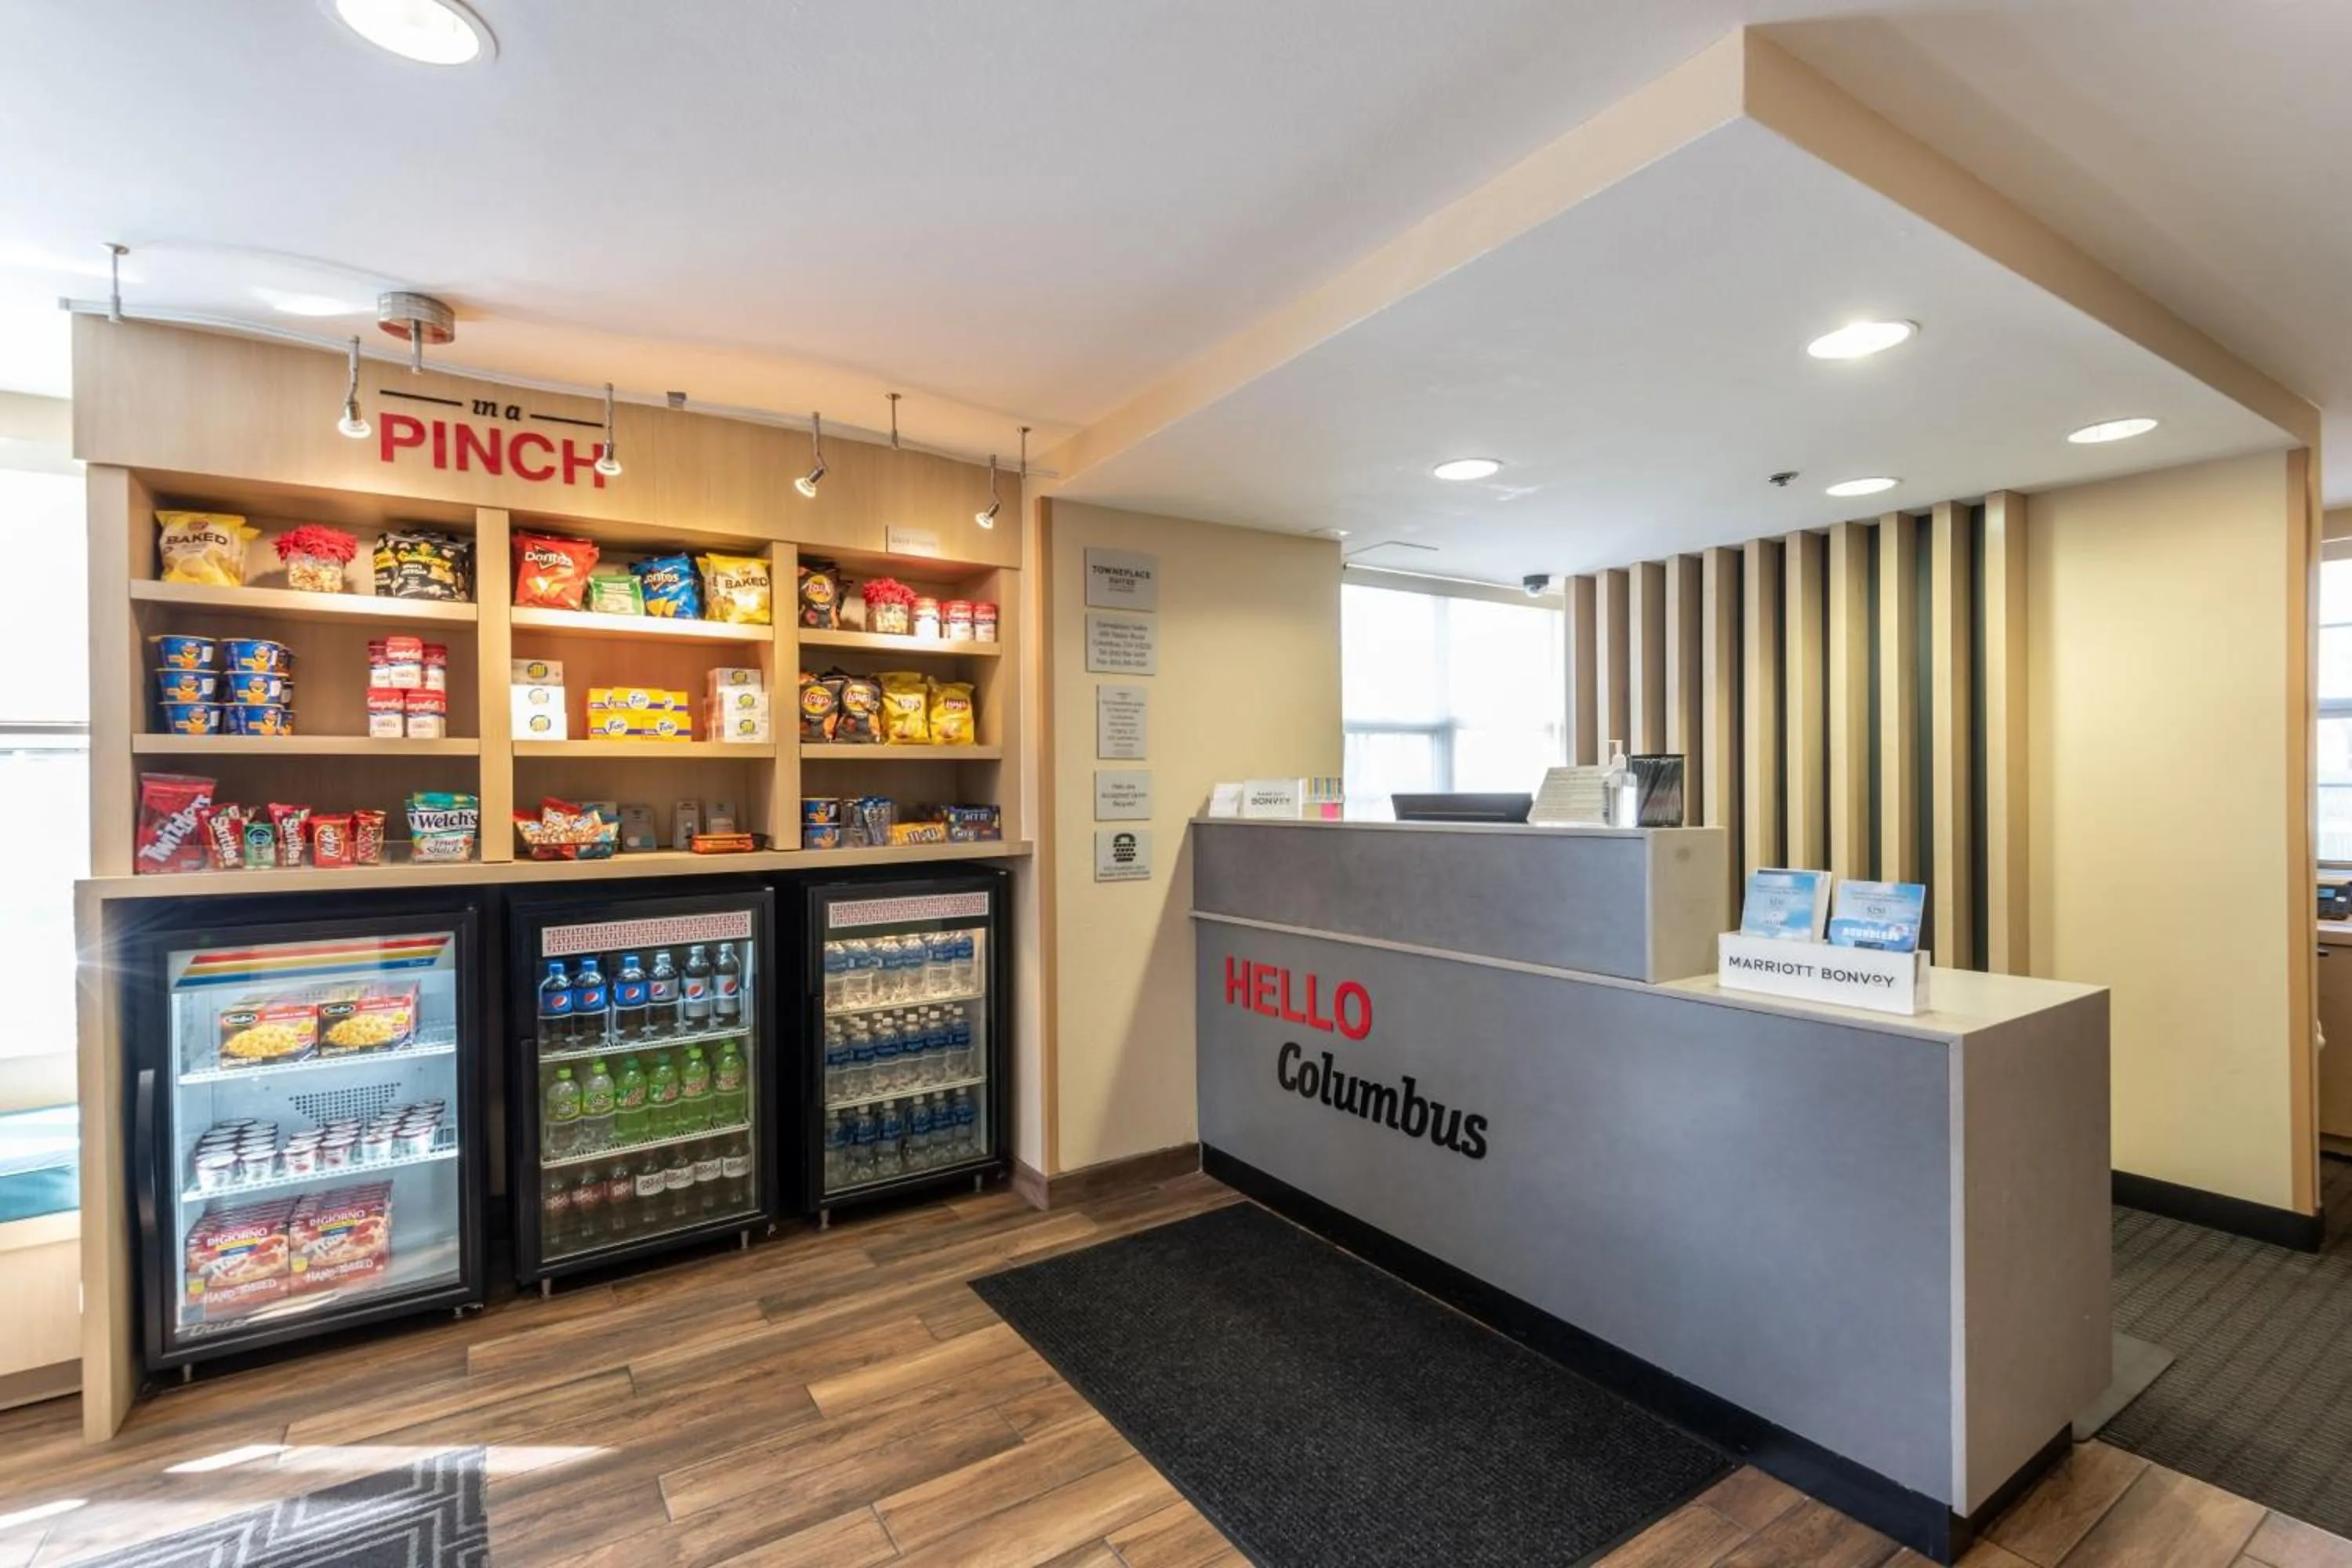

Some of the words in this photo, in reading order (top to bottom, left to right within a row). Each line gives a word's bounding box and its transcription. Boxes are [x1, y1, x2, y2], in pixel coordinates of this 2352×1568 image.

[472, 399, 498, 417] in
[505, 405, 521, 421] a
[379, 412, 605, 488] PINCH
[165, 532, 228, 545] BAKED
[725, 576, 768, 589] BAKED
[418, 811, 478, 829] Welch's
[1728, 956, 1814, 978] MARRIOTT
[1821, 967, 1895, 988] BONVOY
[1225, 953, 1372, 1040] HELLO
[1277, 1041, 1488, 1160] Columbus
